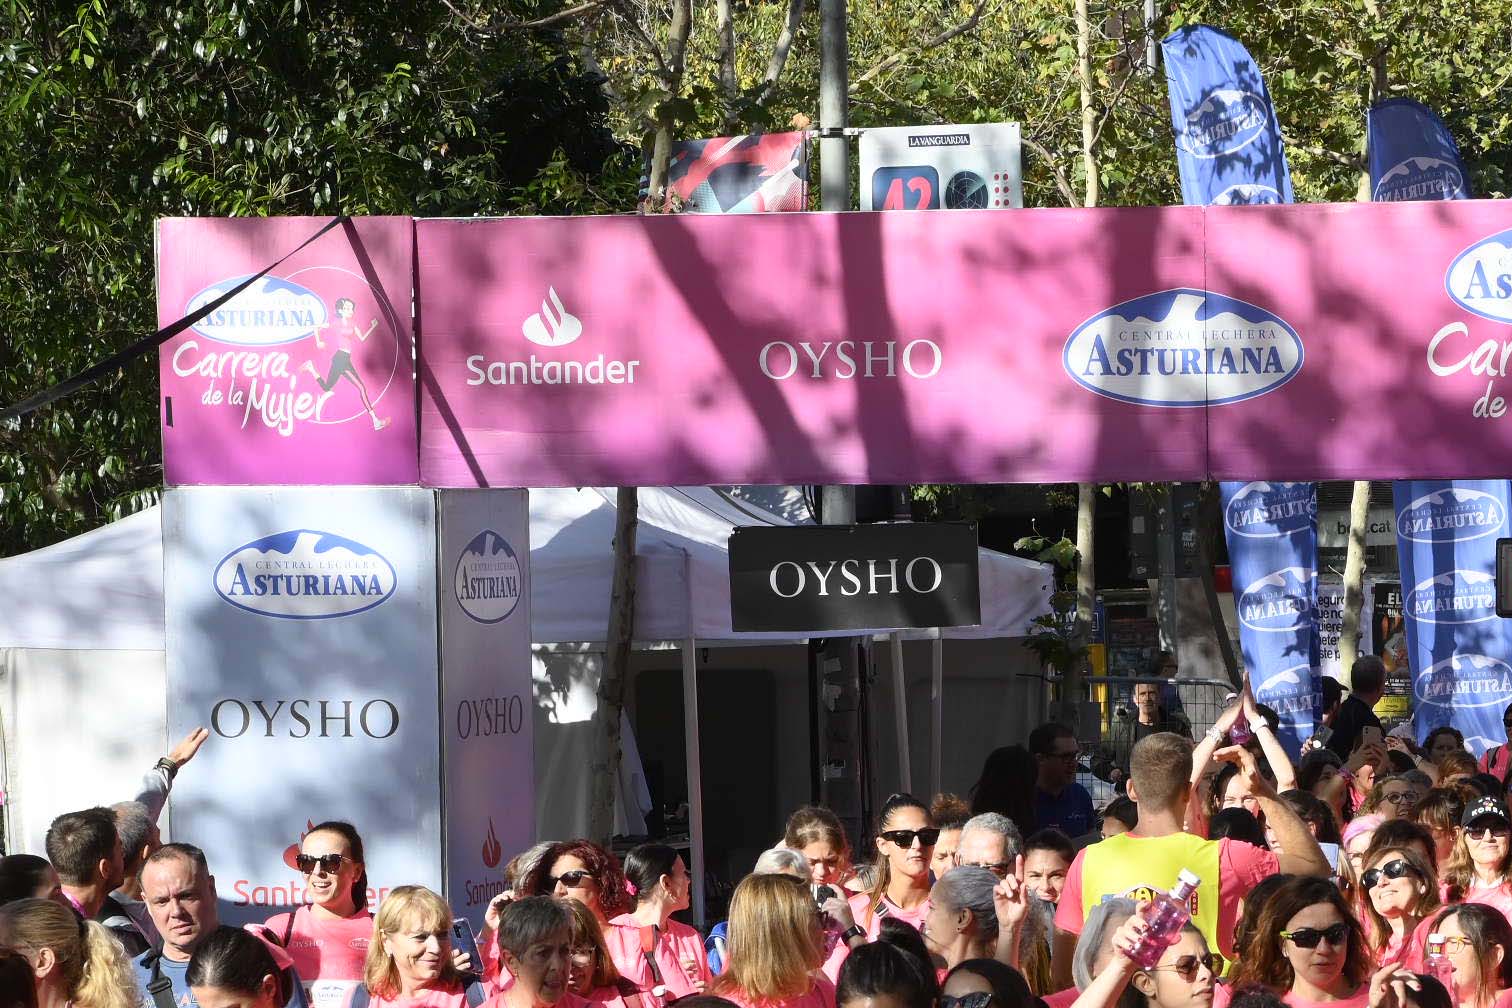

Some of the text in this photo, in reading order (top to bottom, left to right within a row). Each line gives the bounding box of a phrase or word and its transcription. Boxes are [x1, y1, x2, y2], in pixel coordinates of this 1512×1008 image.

[172, 341, 290, 378] Carrera
[466, 354, 641, 387] Santander
[758, 338, 943, 380] OYSHO
[1083, 334, 1285, 376] ASTURIANA
[201, 374, 335, 437] de la Mujer
[1473, 379, 1506, 418] de
[228, 562, 384, 596] ASTURIANA
[256, 560, 313, 569] CENTRAL
[460, 565, 518, 600] ASTURIANA
[769, 556, 943, 598] OYSHO
[211, 699, 400, 739] OYSHO
[457, 694, 523, 740] OYSHO
